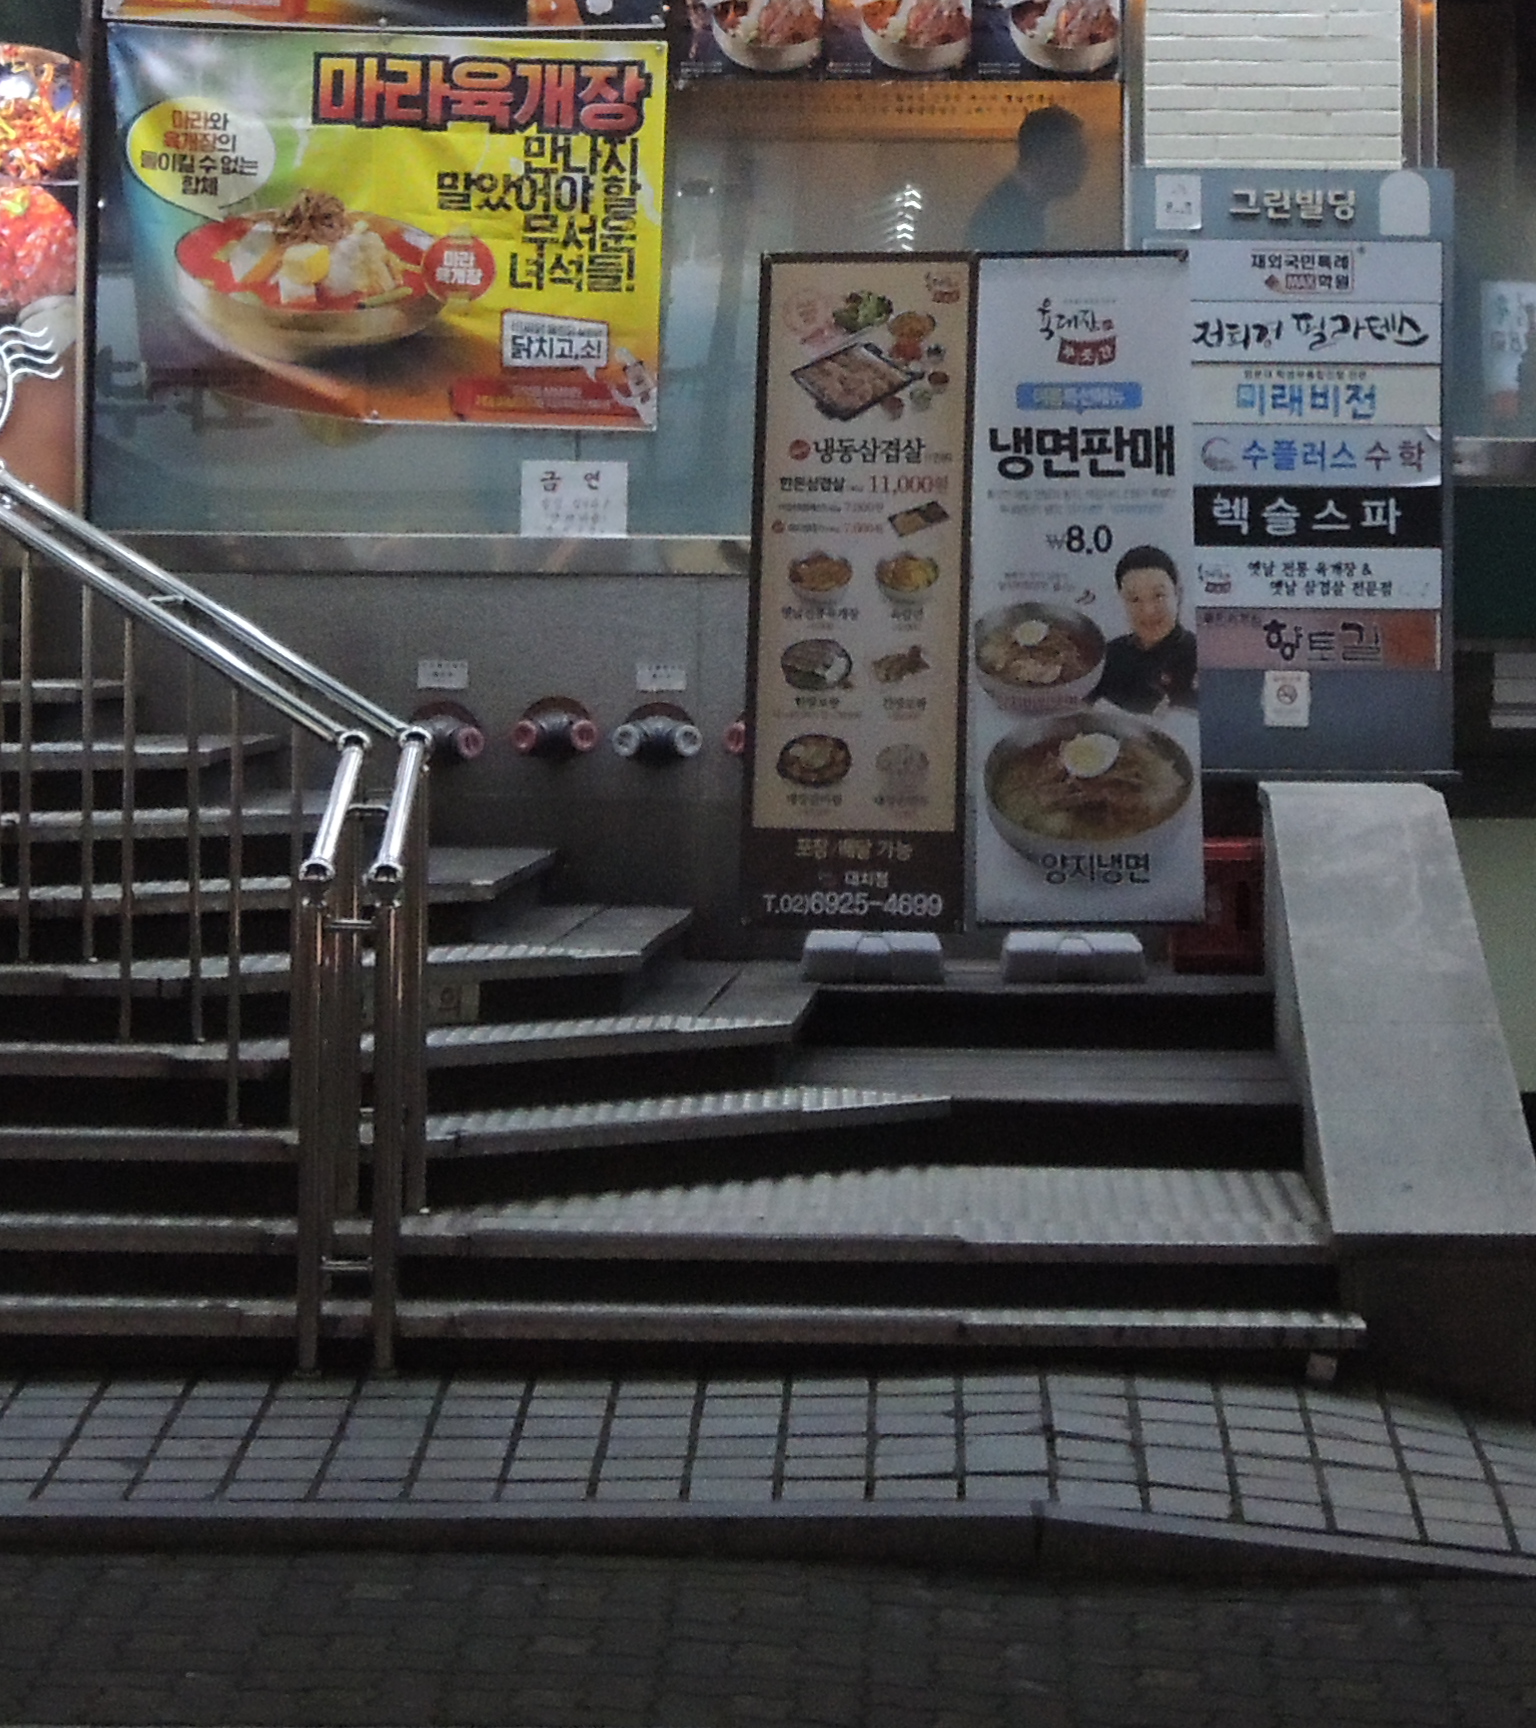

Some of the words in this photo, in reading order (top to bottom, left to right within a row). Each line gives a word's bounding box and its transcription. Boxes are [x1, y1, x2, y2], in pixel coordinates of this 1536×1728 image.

[313, 51, 652, 135] 마라육개장
[172, 110, 229, 131] 마라와
[164, 131, 237, 153] 육개장의
[524, 136, 639, 175] 만나지
[199, 154, 217, 174] 수
[221, 154, 258, 176] 없는
[437, 172, 594, 214] 말았어야
[602, 173, 642, 214] 할
[1229, 188, 1357, 222] 그린빌딩
[522, 213, 637, 256] 무서운
[510, 252, 636, 292] 녀석들!
[1251, 254, 1349, 270] 재외국민특례
[1292, 311, 1428, 350] 필라테스
[1236, 384, 1377, 419] 미래비전
[814, 437, 926, 465] 냉동삼겹살
[988, 425, 1175, 480] 냉면판매
[1241, 440, 1357, 471] 수플러스
[1364, 440, 1426, 472] 수학
[1041, 853, 1150, 885] 양지냉면
